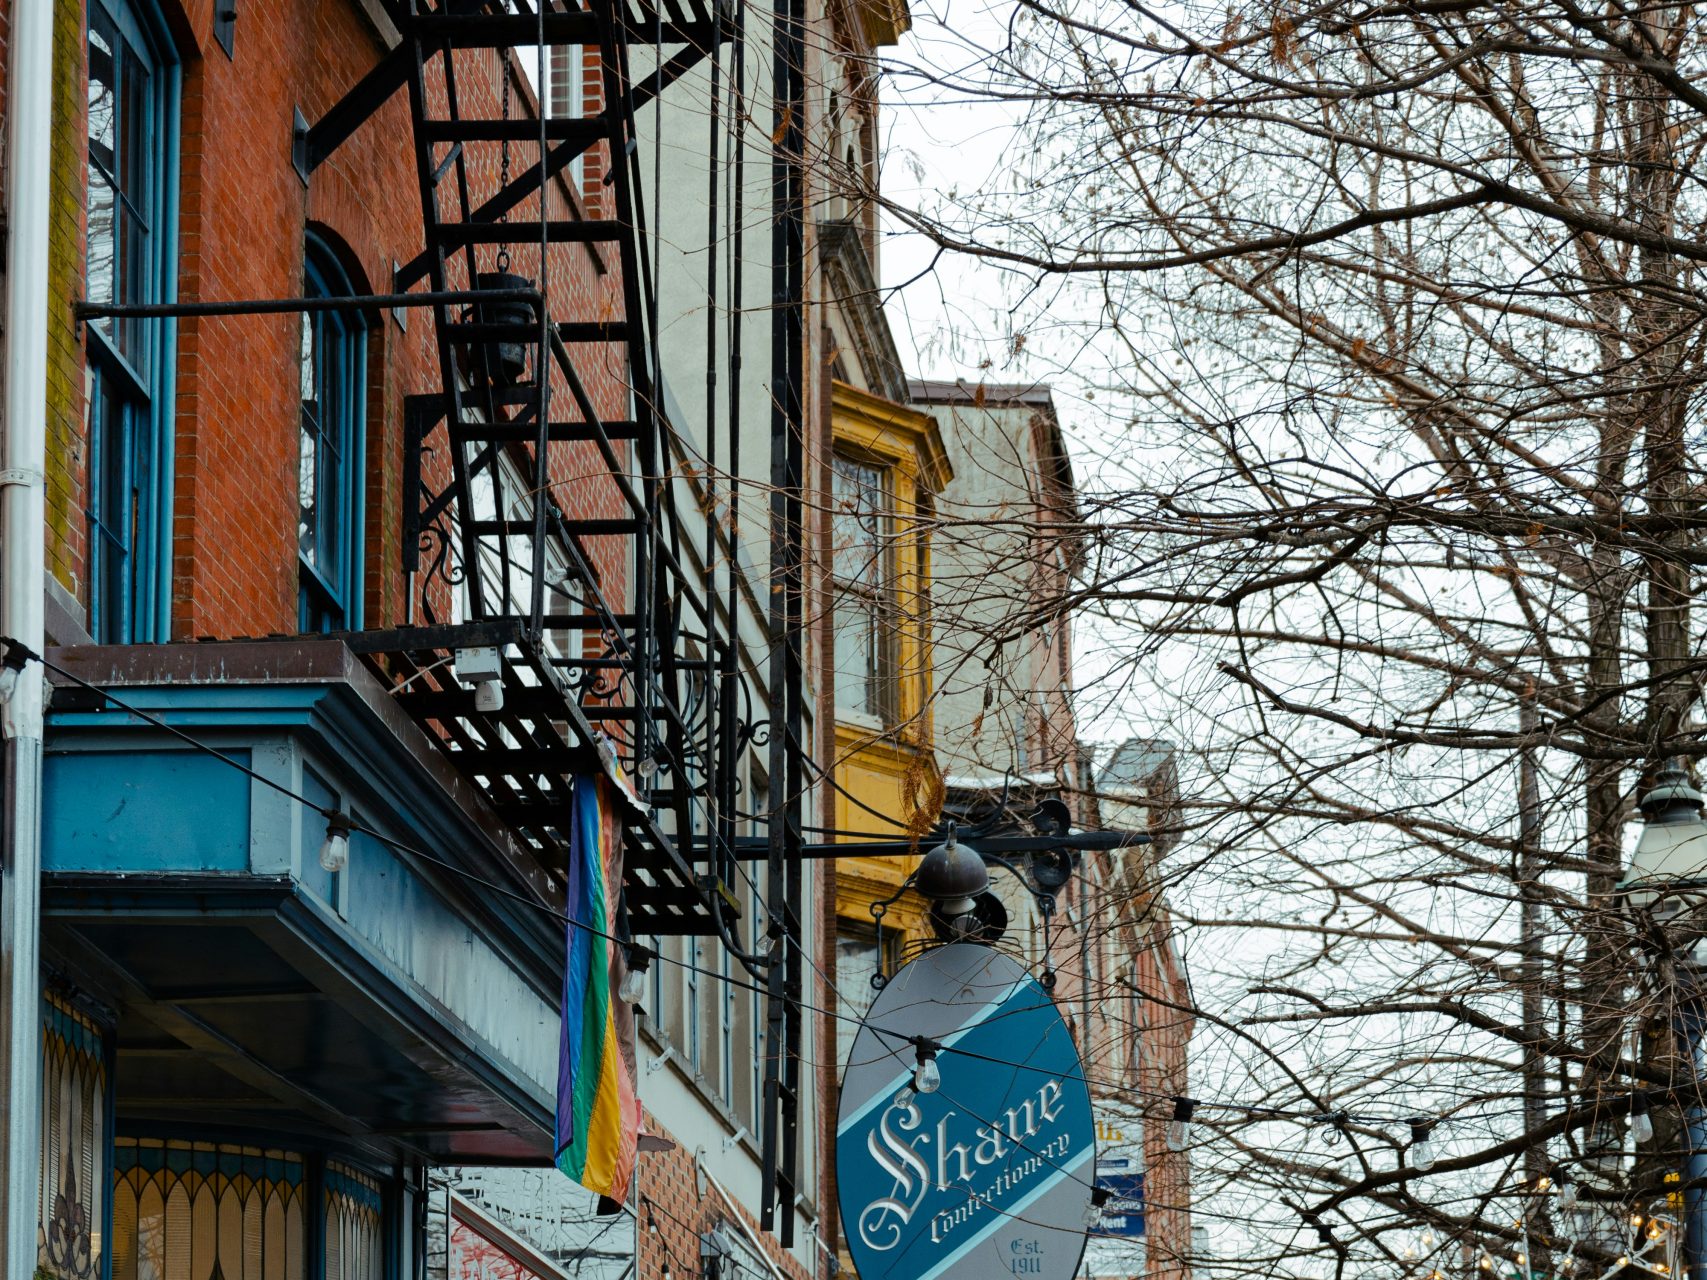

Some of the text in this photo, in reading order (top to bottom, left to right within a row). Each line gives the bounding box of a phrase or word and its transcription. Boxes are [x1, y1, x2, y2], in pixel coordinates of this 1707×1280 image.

[858, 1079, 1065, 1250] Shane
[930, 1132, 1070, 1243] Confectionery
[1010, 1238, 1044, 1255] Est.
[1012, 1257, 1041, 1274] 1911
